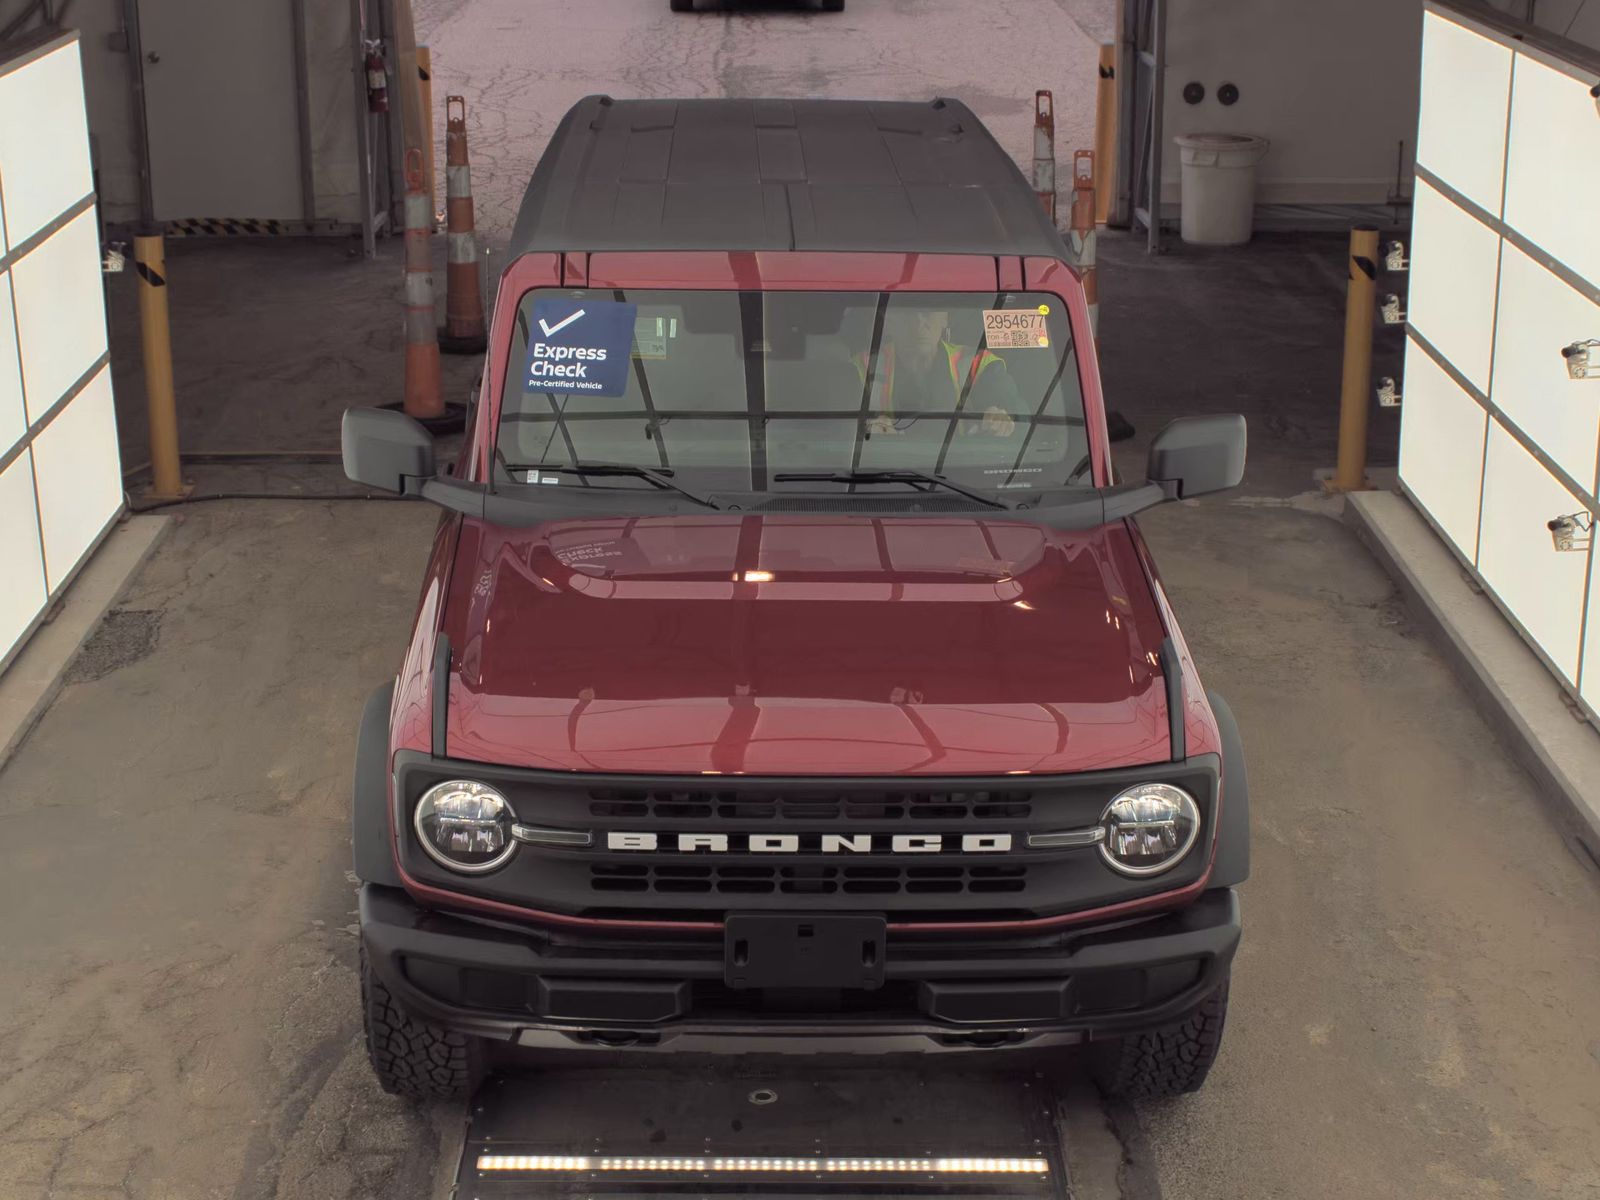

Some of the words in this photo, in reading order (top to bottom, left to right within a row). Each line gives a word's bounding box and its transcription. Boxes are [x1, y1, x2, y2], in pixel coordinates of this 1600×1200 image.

[986, 314, 1044, 329] 2954677
[533, 343, 607, 361] Express
[530, 361, 587, 378] Check
[528, 379, 575, 388] Pre-Certified
[576, 381, 602, 390] Vehicle
[607, 832, 1012, 853] BRONCO
